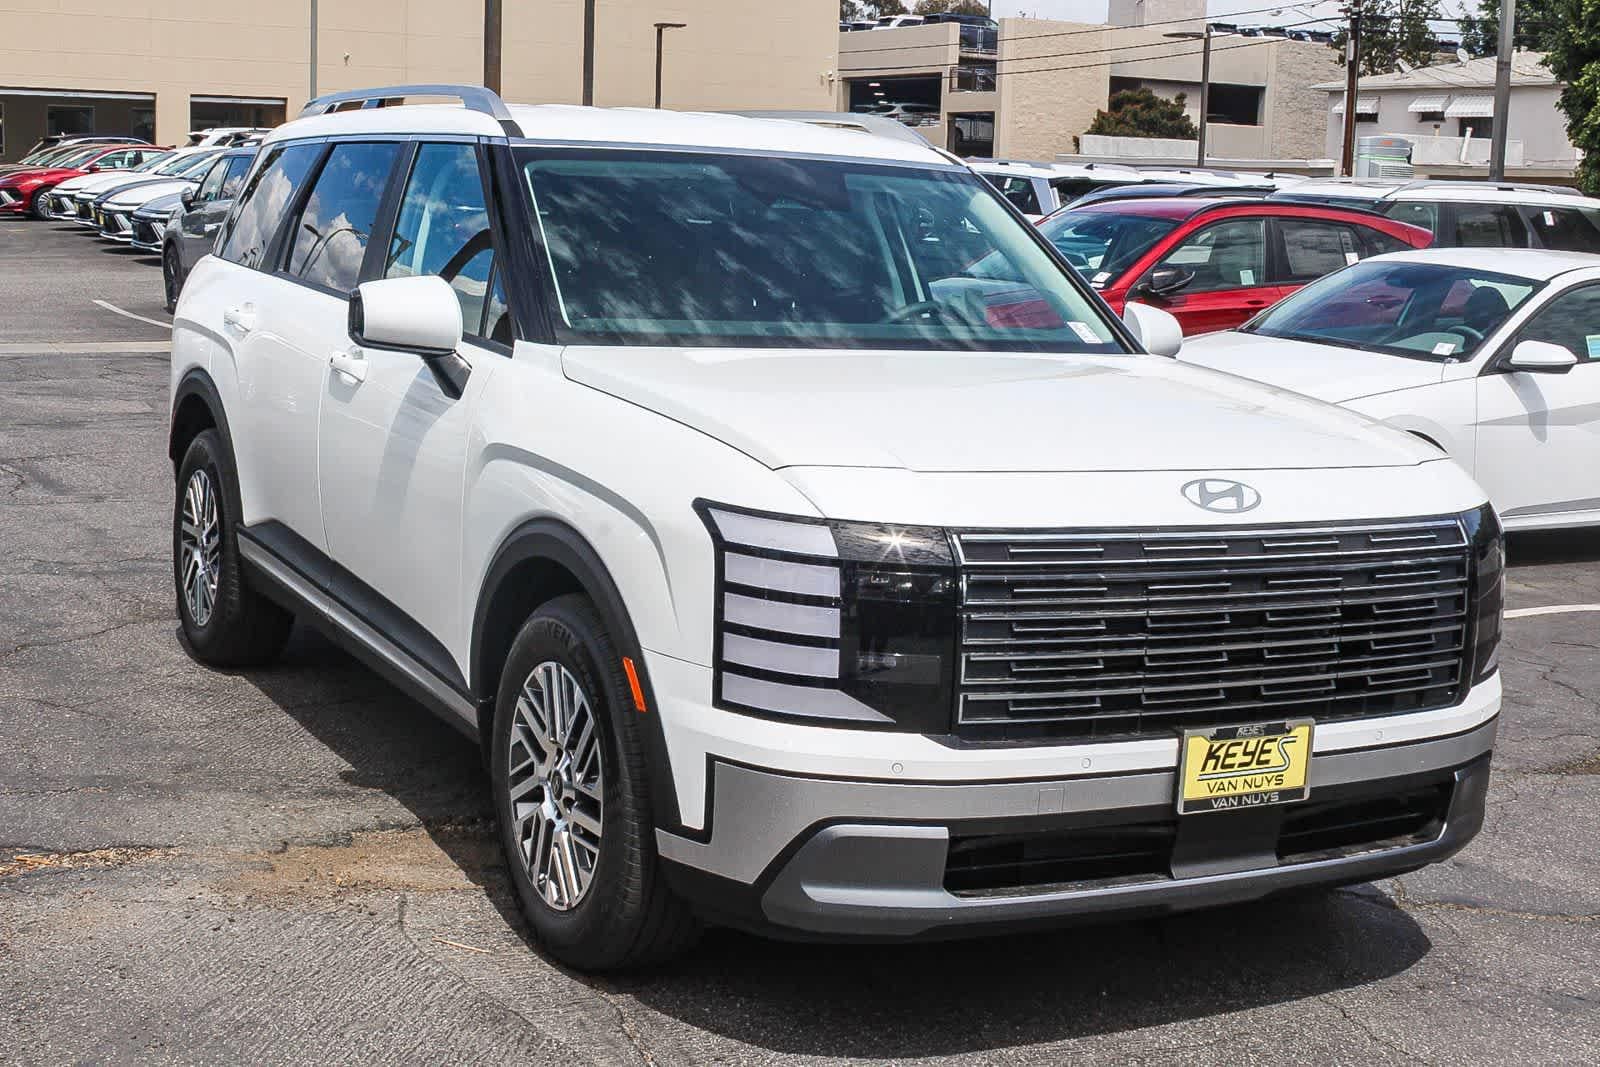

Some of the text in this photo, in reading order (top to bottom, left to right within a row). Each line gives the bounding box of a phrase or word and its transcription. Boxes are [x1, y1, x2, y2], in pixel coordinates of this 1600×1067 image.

[1200, 736, 1298, 778] KEYES
[1207, 774, 1284, 793] VAN NUYS
[1211, 792, 1279, 808] VAN NUYS
